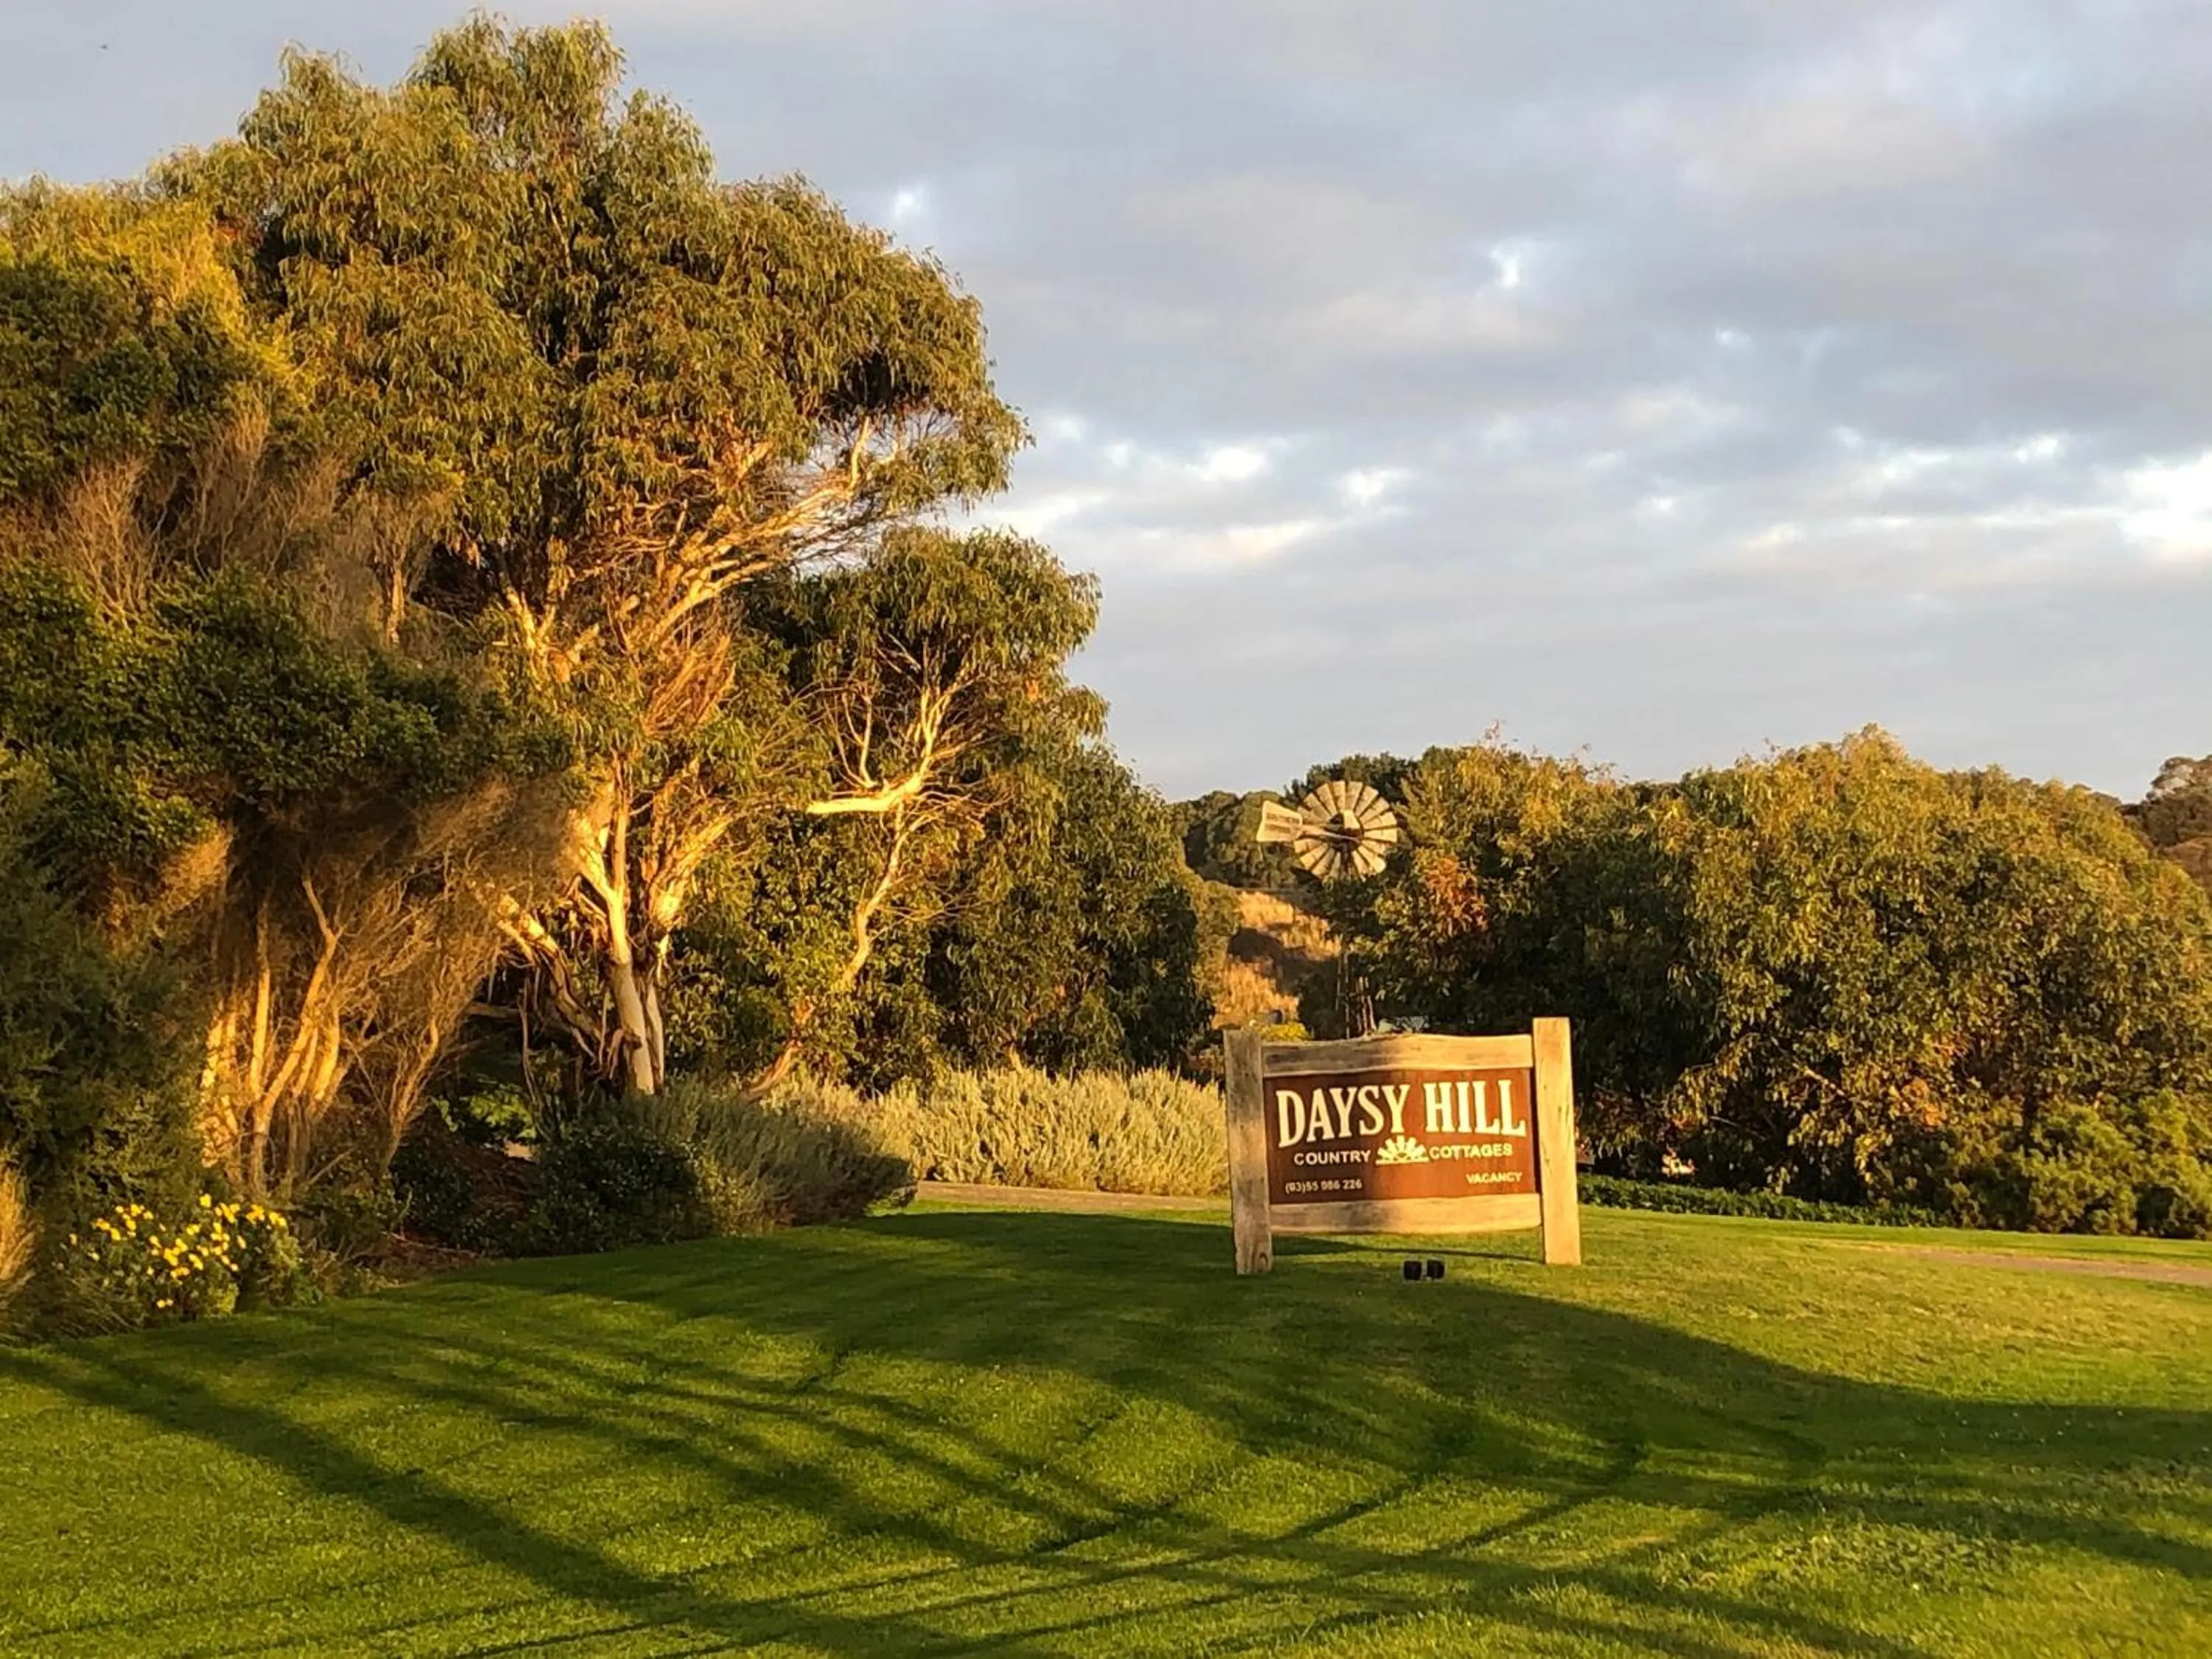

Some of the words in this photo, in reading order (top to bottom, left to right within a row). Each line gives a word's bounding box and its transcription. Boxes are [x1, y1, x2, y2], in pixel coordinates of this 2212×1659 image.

[1276, 1084, 1410, 1148] DAYSY
[1422, 1079, 1526, 1136] HILL
[1294, 1150, 1371, 1166] COUNTRY
[1429, 1143, 1513, 1161] COTTAGES
[1466, 1172, 1522, 1185] VACANCY
